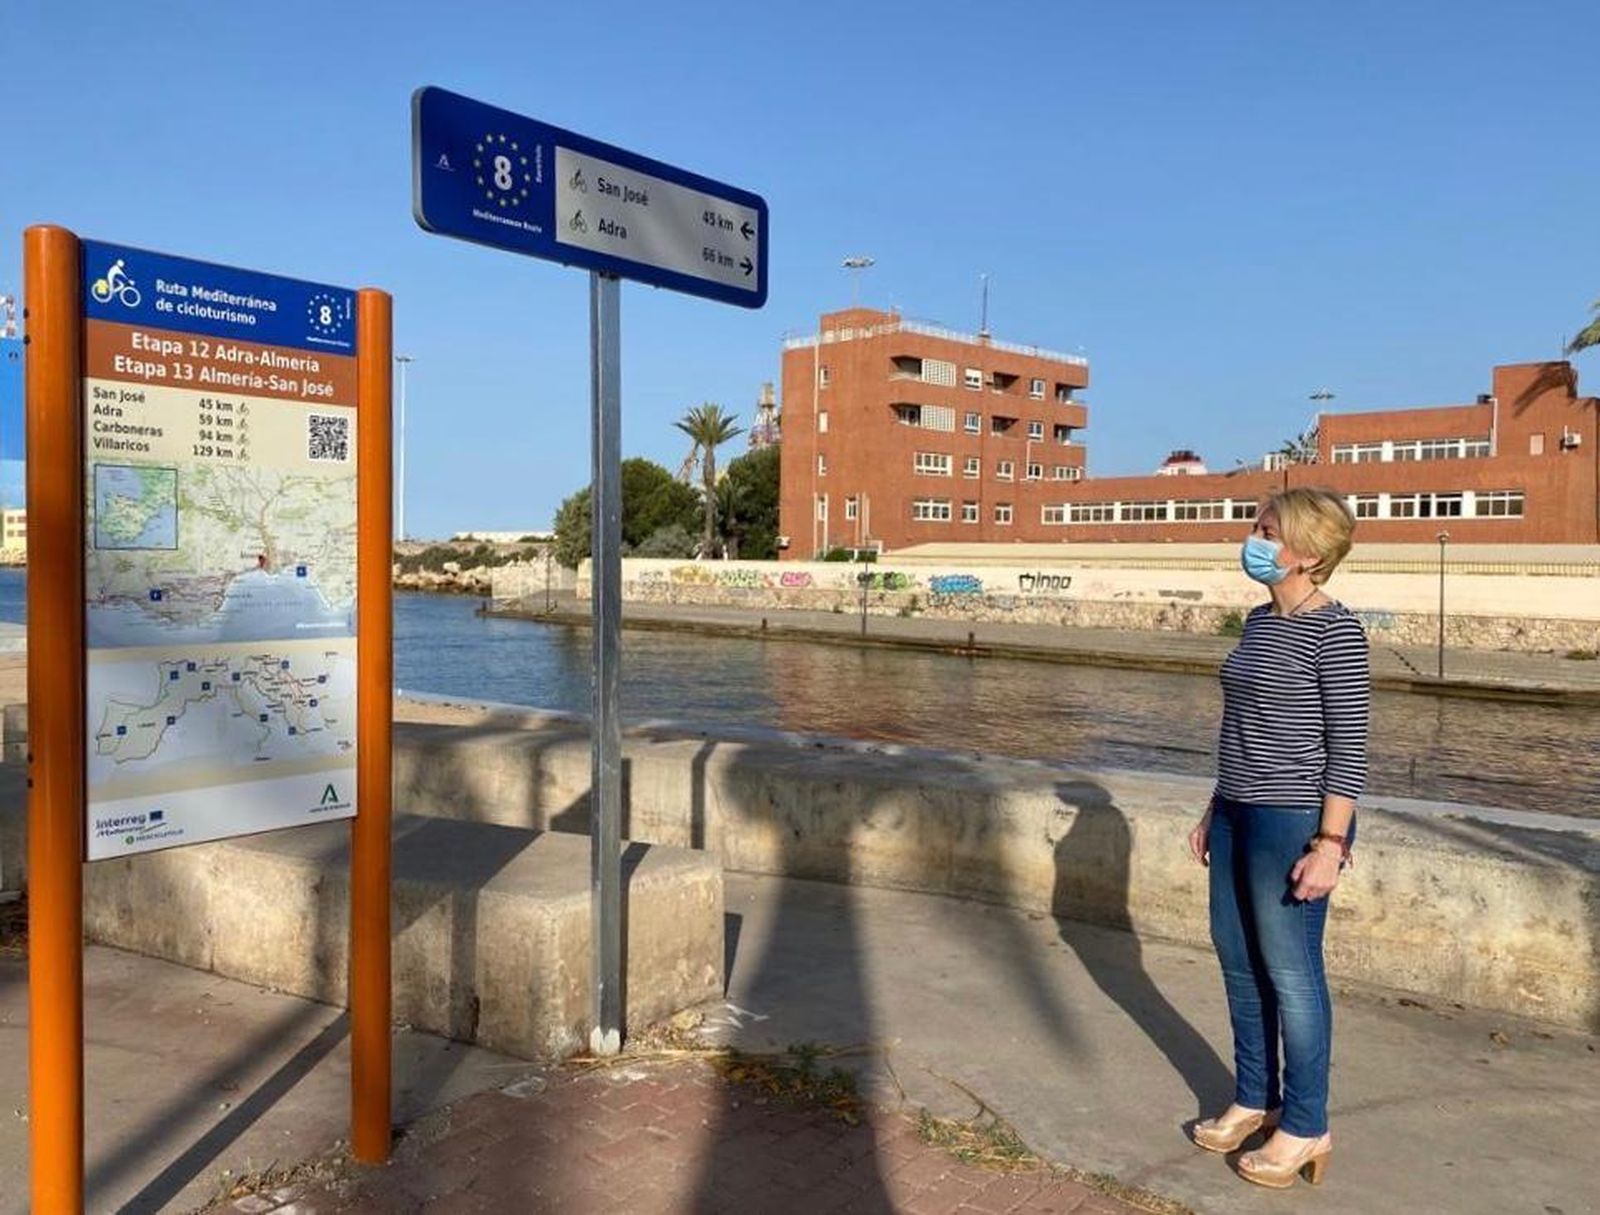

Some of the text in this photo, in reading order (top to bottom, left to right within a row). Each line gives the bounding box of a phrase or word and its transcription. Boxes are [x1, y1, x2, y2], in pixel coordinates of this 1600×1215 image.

[494, 155, 513, 190] 8
[597, 177, 649, 206] San José
[598, 218, 628, 239] Adra
[702, 210, 734, 232] 45 km
[717, 249, 735, 269] km
[156, 279, 278, 312] Ruta Mediterránea
[156, 298, 257, 325] de cicloturismo
[319, 305, 333, 325] 8
[132, 332, 321, 373] Etapa 12 Adra-Almería
[114, 355, 335, 399] Etapa 13 Almería-San José
[93, 387, 146, 403] San José
[93, 403, 123, 418] Adra
[198, 398, 234, 413] 45 km
[93, 420, 164, 438] Carboneras
[198, 413, 234, 427] 59 km
[93, 437, 150, 453] Villaricos
[198, 428, 233, 443] 94 km
[192, 444, 234, 459] 129 km
[95, 813, 147, 830] Interreg
